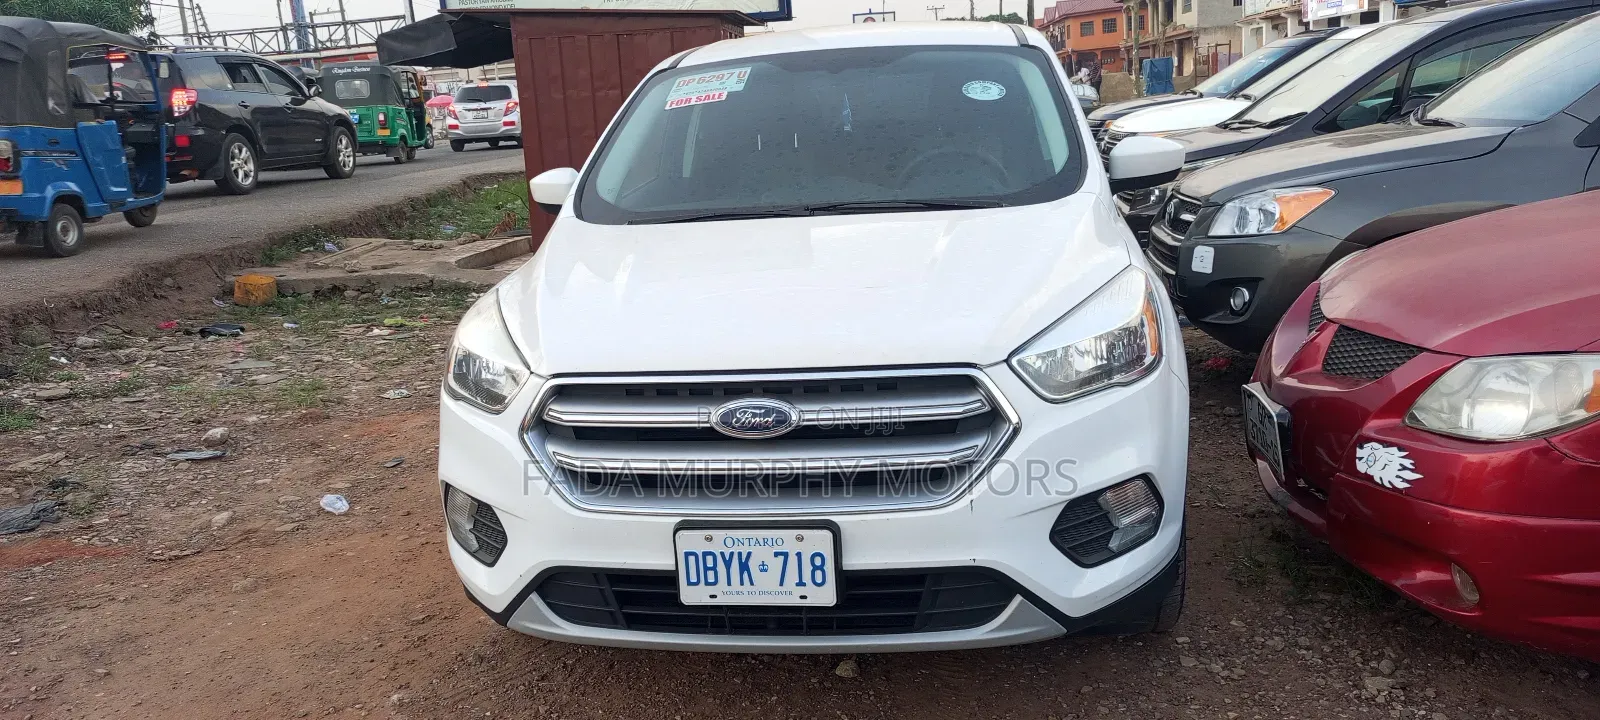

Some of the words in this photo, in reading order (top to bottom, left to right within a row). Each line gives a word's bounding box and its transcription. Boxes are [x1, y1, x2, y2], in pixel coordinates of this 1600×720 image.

[675, 78, 696, 88] DP
[668, 97, 693, 108] FOR
[694, 92, 725, 103] SALE
[732, 408, 776, 427] Ford
[683, 551, 755, 586] DBYK
[773, 551, 827, 587] 718
